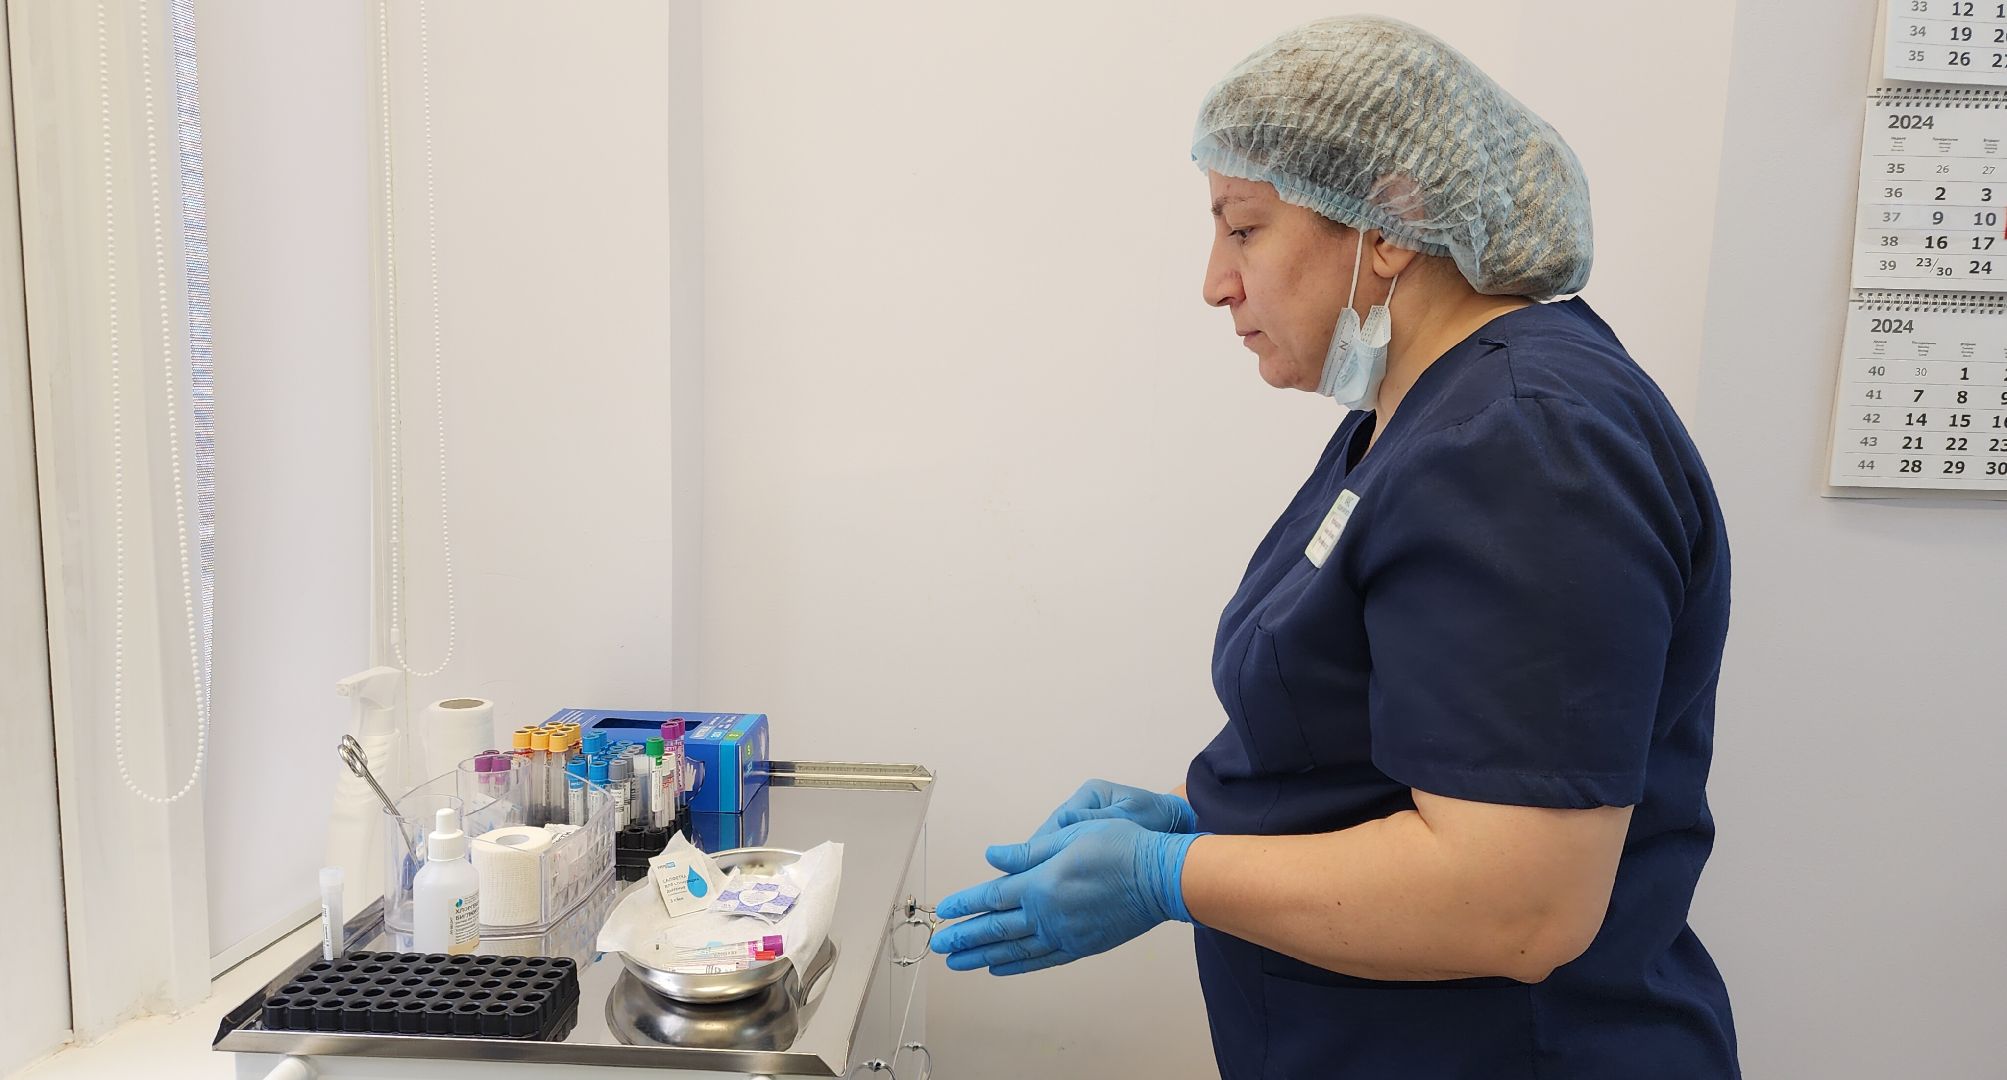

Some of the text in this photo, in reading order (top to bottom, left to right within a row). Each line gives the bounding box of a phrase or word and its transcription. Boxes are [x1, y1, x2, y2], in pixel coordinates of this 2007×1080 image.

[1911, 0, 1928, 13] 33
[1952, 1, 1974, 17] 12
[1909, 25, 2007, 43] 34 19 2
[1908, 49, 1925, 62] 35
[1948, 51, 1971, 67] 26
[1887, 114, 1935, 130] 2024
[1886, 162, 1996, 175] 35 26 27
[1884, 186, 1992, 202] 36 2 3
[1882, 211, 1997, 227] 37 9 10
[1880, 235, 1996, 251] 38 16 17
[1879, 259, 1897, 271] 39
[1968, 260, 1993, 275] 24
[1870, 318, 1914, 334] 2024
[1867, 365, 1970, 381] 40 30 1
[1865, 389, 1883, 400] 41
[1913, 389, 1925, 403] 7
[1956, 390, 1968, 405] 8
[1862, 413, 1881, 424] 42
[1905, 412, 1928, 427] 14
[1948, 413, 1972, 428] 15
[1859, 436, 1878, 447] 43
[1901, 435, 1924, 450] 21
[1945, 437, 1968, 451] 22
[1857, 459, 1875, 471] 44
[1899, 459, 1923, 474] 28
[1942, 460, 1966, 475] 29
